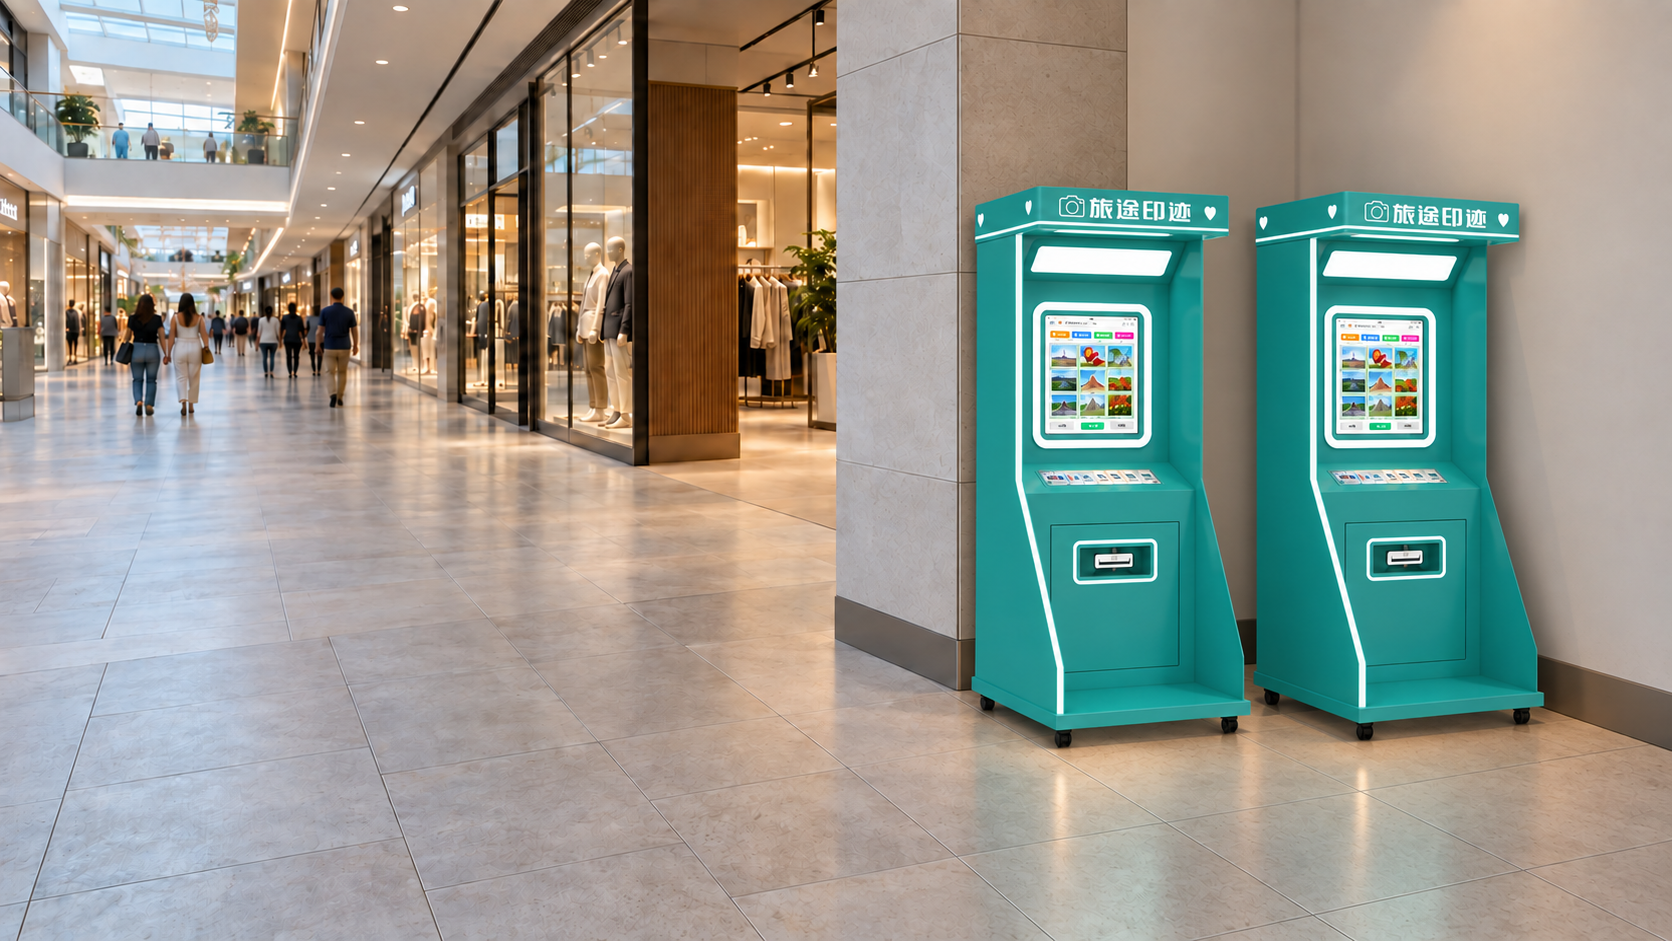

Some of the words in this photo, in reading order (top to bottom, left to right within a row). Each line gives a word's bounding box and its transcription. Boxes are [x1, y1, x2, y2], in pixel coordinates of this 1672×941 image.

[1089, 197, 1192, 223] 旅途印迹
[1393, 203, 1487, 229] 旅途印迹
